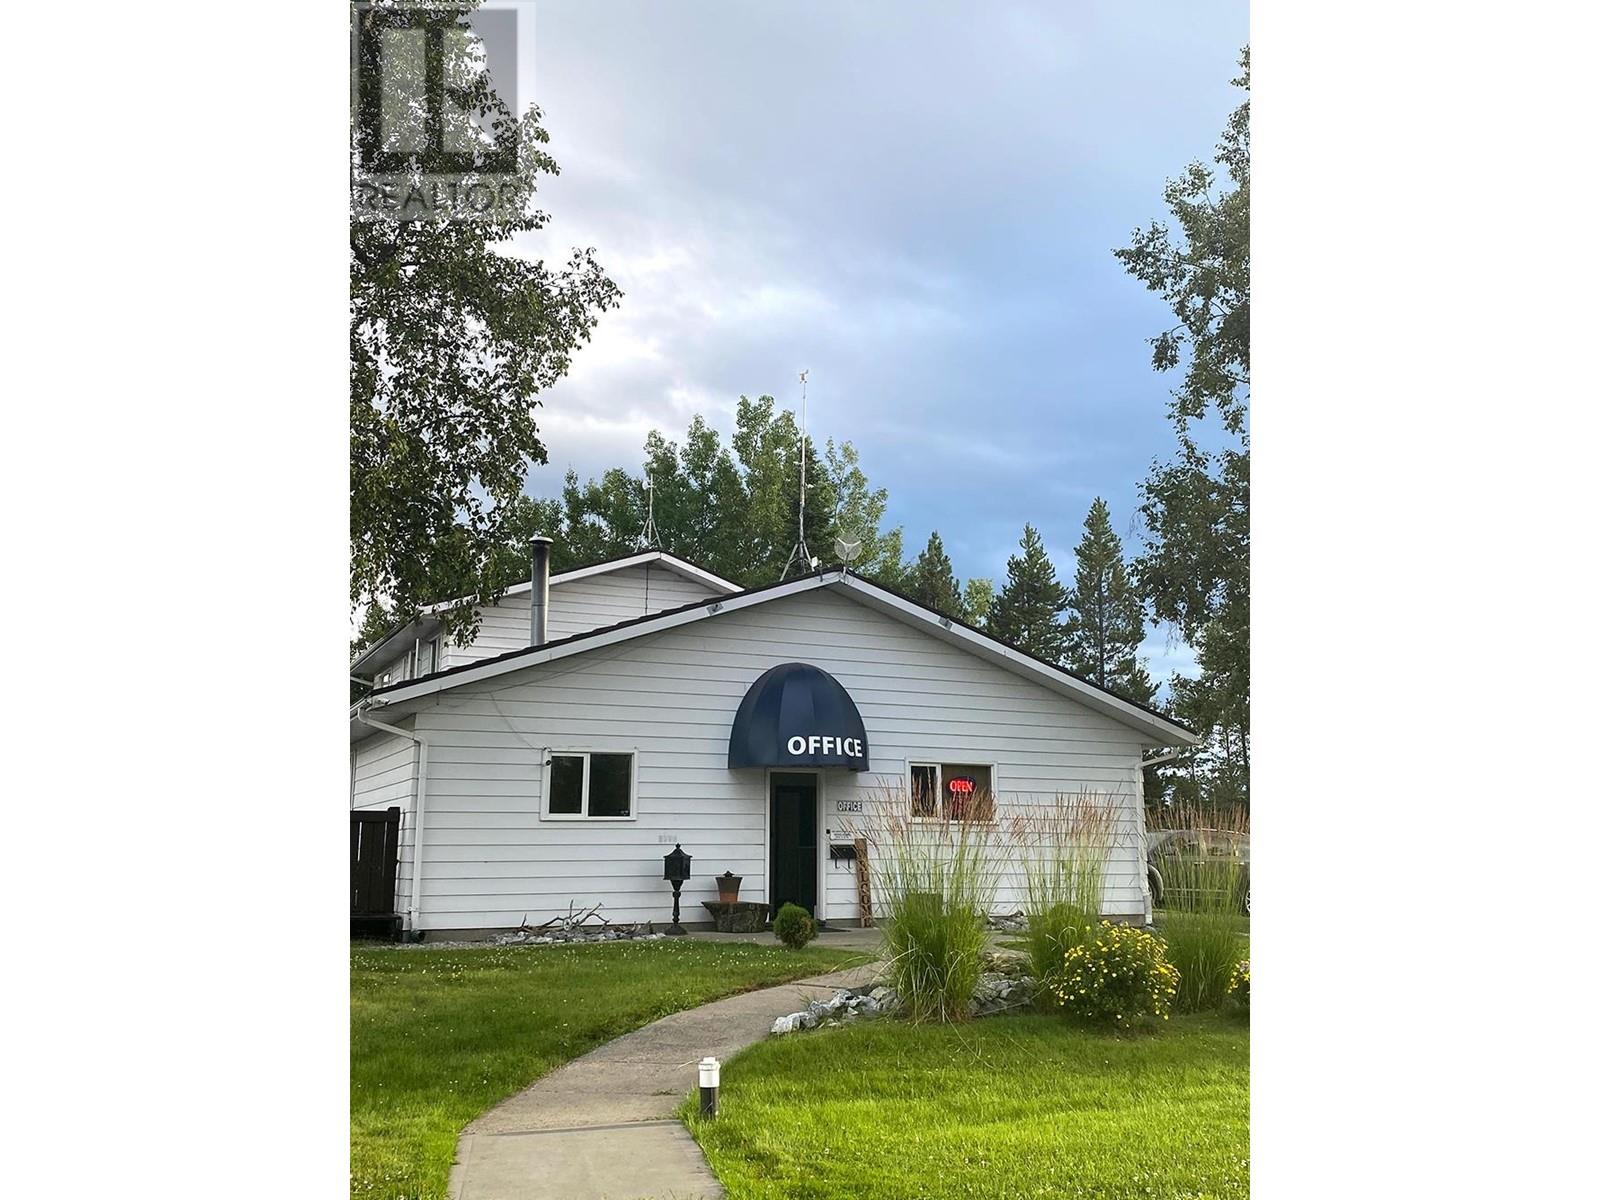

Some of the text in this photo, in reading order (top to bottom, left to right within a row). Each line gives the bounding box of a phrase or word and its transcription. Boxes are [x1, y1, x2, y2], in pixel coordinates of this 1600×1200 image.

[787, 735, 863, 757] OFFICE
[950, 780, 973, 792] OPEN
[837, 800, 862, 811] OFFICE
